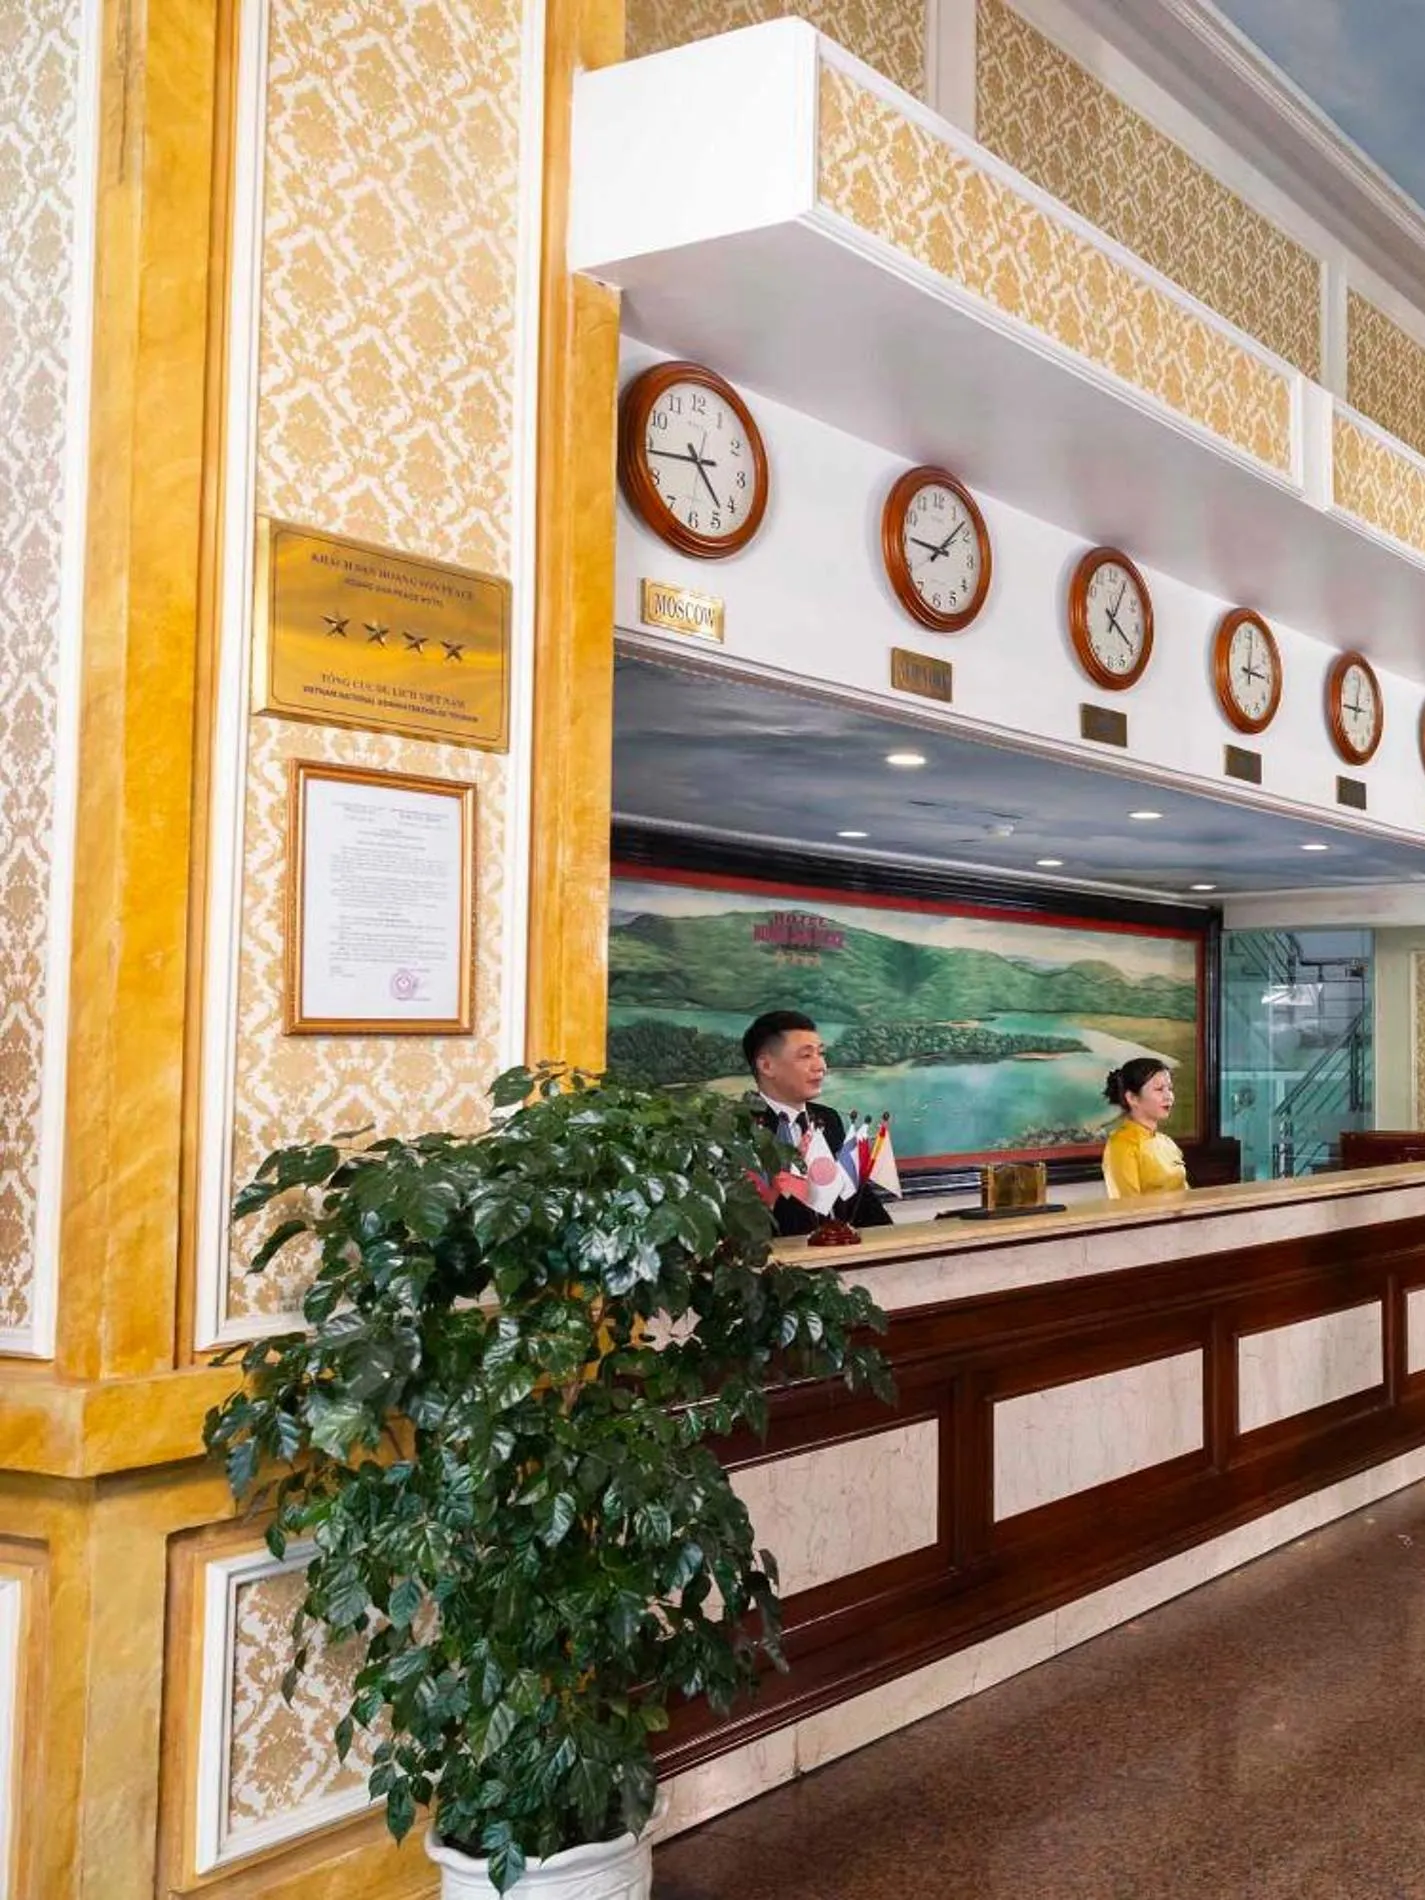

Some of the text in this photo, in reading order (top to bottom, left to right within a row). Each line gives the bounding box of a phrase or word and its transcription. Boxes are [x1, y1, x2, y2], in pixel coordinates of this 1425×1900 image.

[668, 394, 681, 415] 11
[692, 393, 706, 415] 12
[651, 410, 667, 430] 10
[717, 412, 722, 430] 1
[731, 439, 740, 456] 2
[737, 471, 746, 488] 3
[727, 496, 735, 514] 4
[933, 492, 945, 509] 12
[688, 512, 698, 529] 6
[710, 512, 721, 529] 5
[654, 591, 715, 629] MOSCOW
